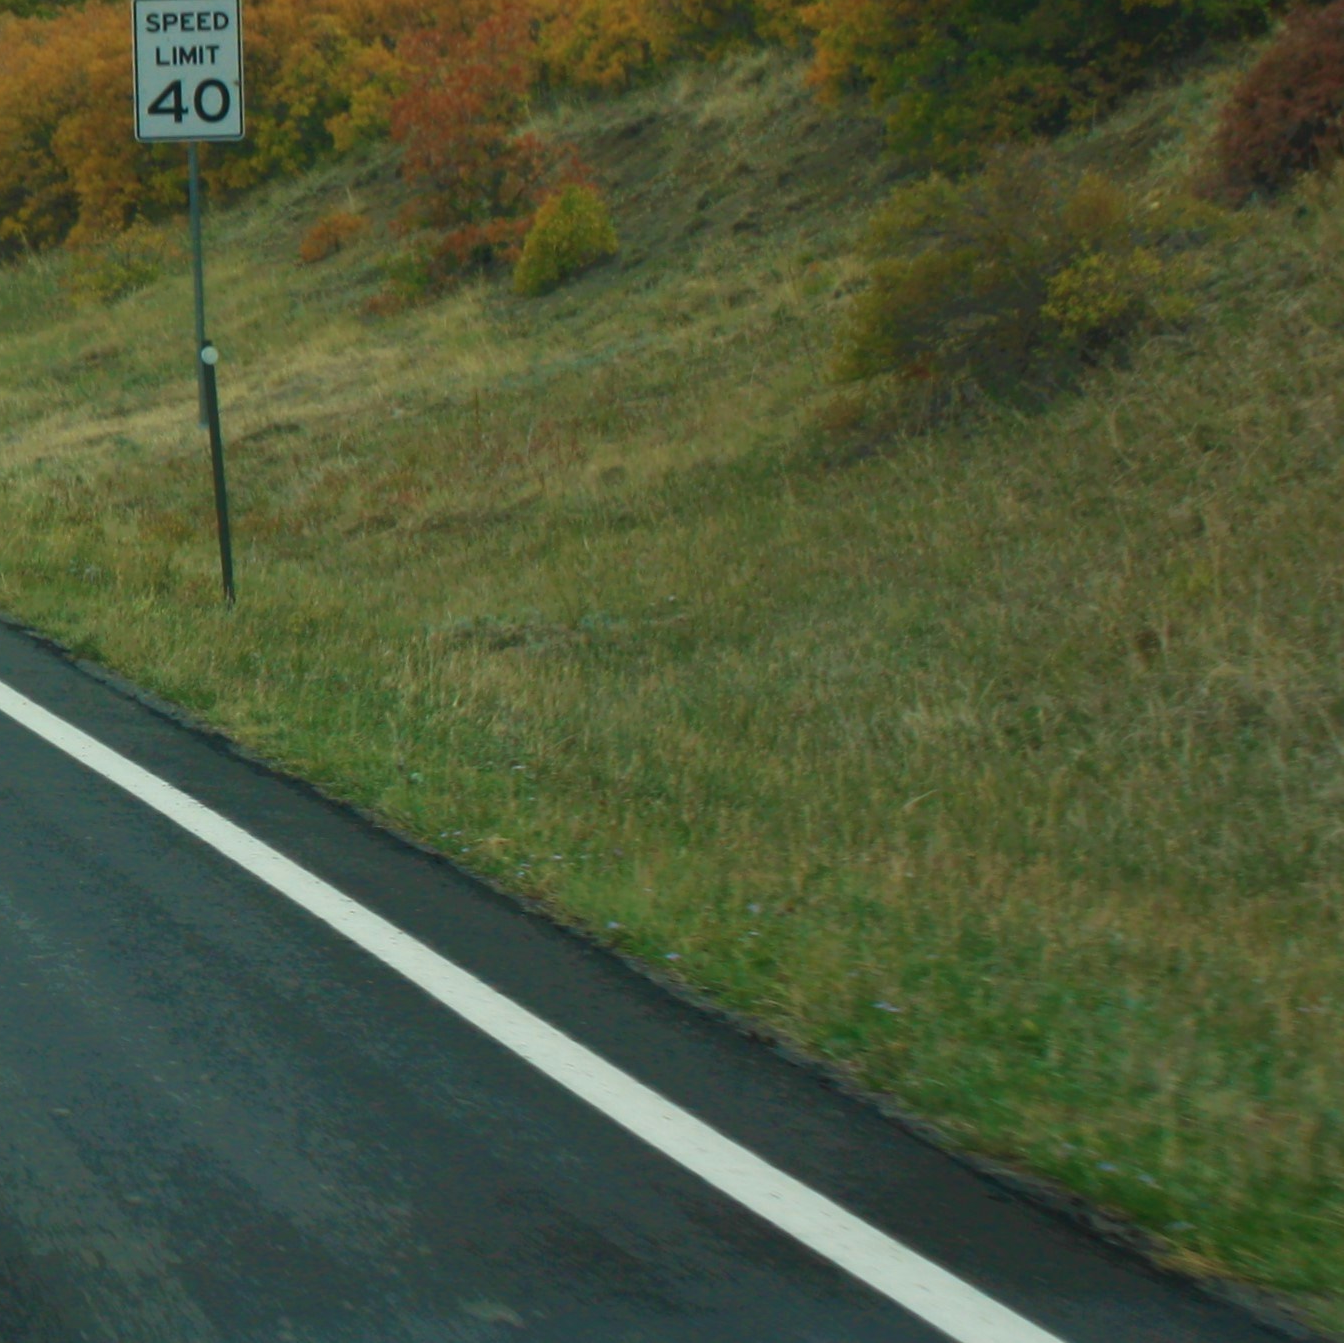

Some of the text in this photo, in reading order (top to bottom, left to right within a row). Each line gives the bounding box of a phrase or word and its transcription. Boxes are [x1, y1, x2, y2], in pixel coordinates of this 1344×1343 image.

[146, 12, 229, 33] SPEED
[156, 45, 219, 66] LIMIT
[148, 79, 231, 123] 40
